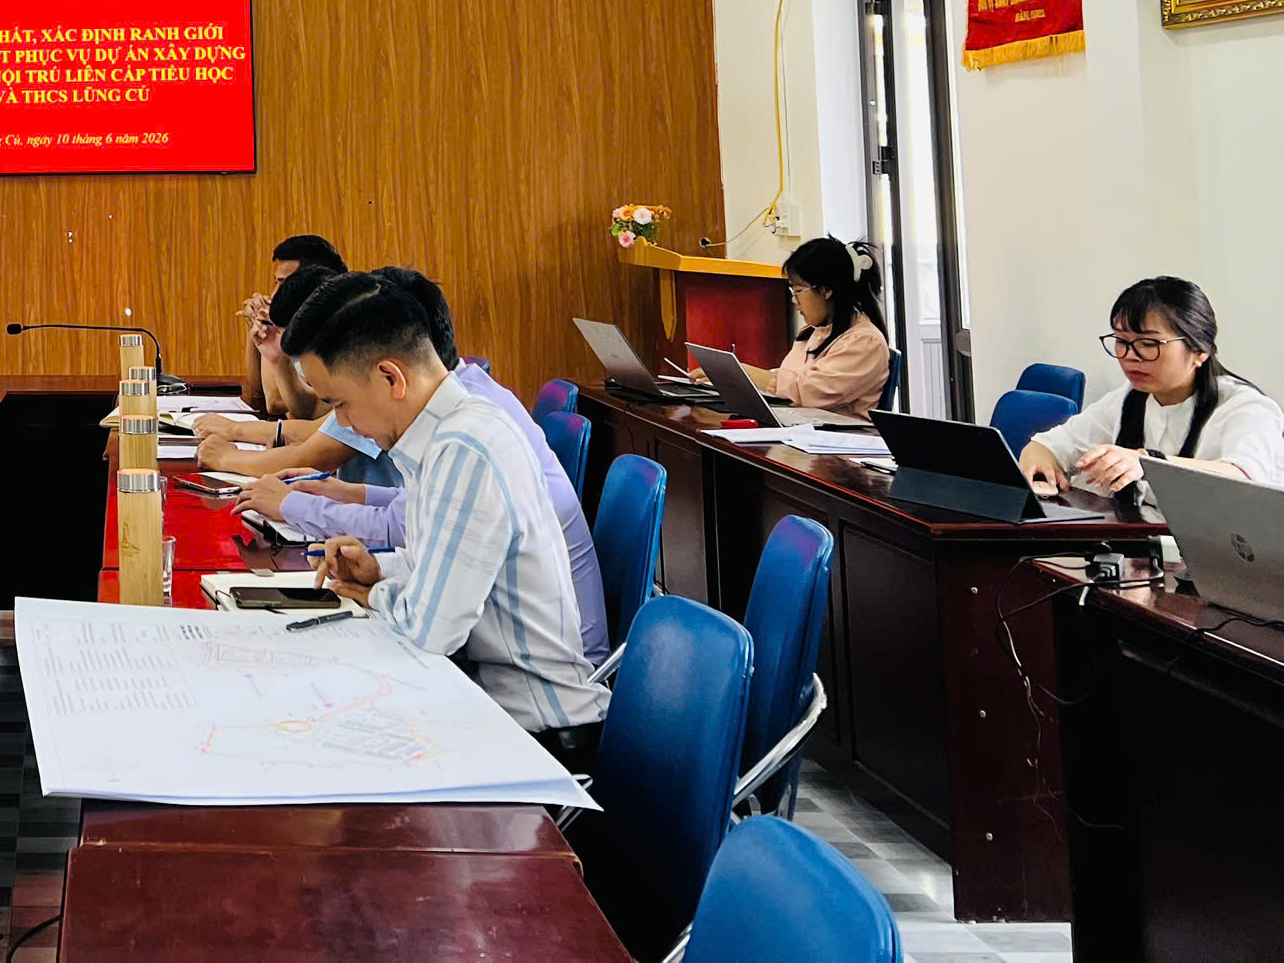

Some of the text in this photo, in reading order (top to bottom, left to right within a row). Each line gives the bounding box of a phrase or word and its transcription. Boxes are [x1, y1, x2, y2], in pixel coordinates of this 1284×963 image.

[40, 24, 77, 42] XÁC
[81, 28, 126, 45] ĐỊNH
[130, 27, 179, 42] RANH
[184, 23, 224, 40] GIỚI
[15, 49, 63, 66] PHỤC
[66, 48, 91, 65] VỤ
[95, 47, 122, 64] DỰ
[125, 45, 149, 61] ÁN
[153, 44, 190, 61] XÂY
[194, 45, 246, 63] DỰNG
[25, 66, 60, 83] TRÚ
[65, 65, 106, 82] LIÊN
[111, 65, 146, 82] CẤP
[148, 65, 190, 82] TIỂU
[195, 67, 234, 83] HỌC
[22, 90, 68, 103] THCS
[73, 86, 121, 102] LŨNG
[125, 85, 149, 102] CÚ
[27, 135, 53, 147] ngày
[56, 134, 70, 144] 10
[72, 133, 103, 146] tháng
[105, 133, 113, 144] 6
[141, 133, 169, 144] 2026
